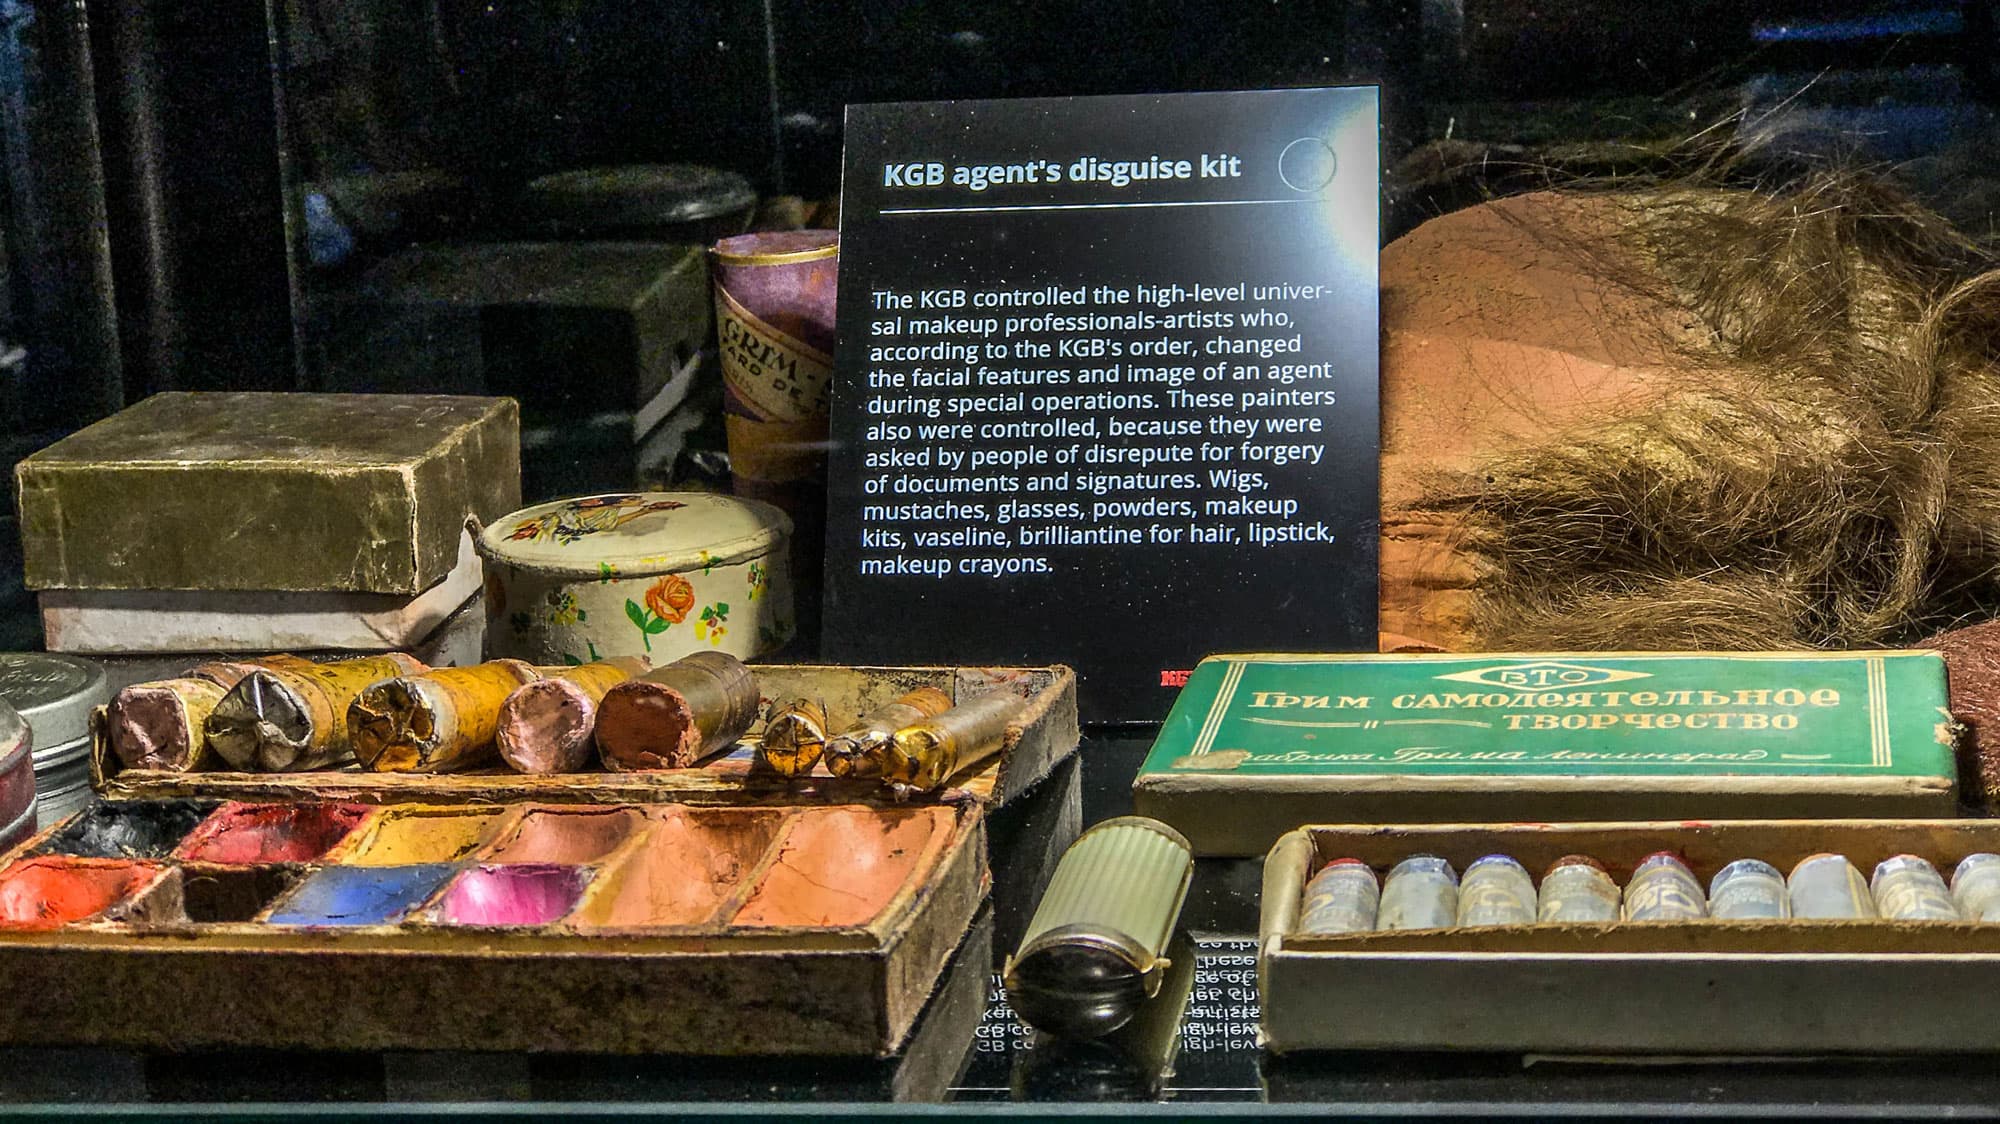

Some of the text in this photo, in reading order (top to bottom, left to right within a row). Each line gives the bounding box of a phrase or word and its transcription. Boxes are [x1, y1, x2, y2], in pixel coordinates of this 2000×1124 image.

[885, 154, 1241, 191] KGB agent's disguise kit
[873, 282, 1331, 310] The KGB controlled the high-level univer-
[871, 308, 1294, 339] sal makeup professionals-artists who,
[870, 334, 1301, 365] according to the KGB's order, changed
[869, 361, 1332, 388] the facial features and image of an agent
[868, 388, 1335, 416] during special operations. These painters
[867, 415, 1322, 441] also were controlled, because they were
[866, 441, 1324, 472] asked by people of disrepute for forgery
[865, 468, 1268, 495] of documents and signatures. Wigs,
[864, 495, 1297, 524] mustaches, glasses, powders, makeup
[863, 521, 1334, 550] kits, vaseline, brilliantine for hair, lipstick,
[862, 555, 1053, 579] makeup crayons.
[1500, 669, 1589, 686] ВТО
[1245, 750, 1375, 763] абрика
[1379, 746, 1529, 763] Грима
